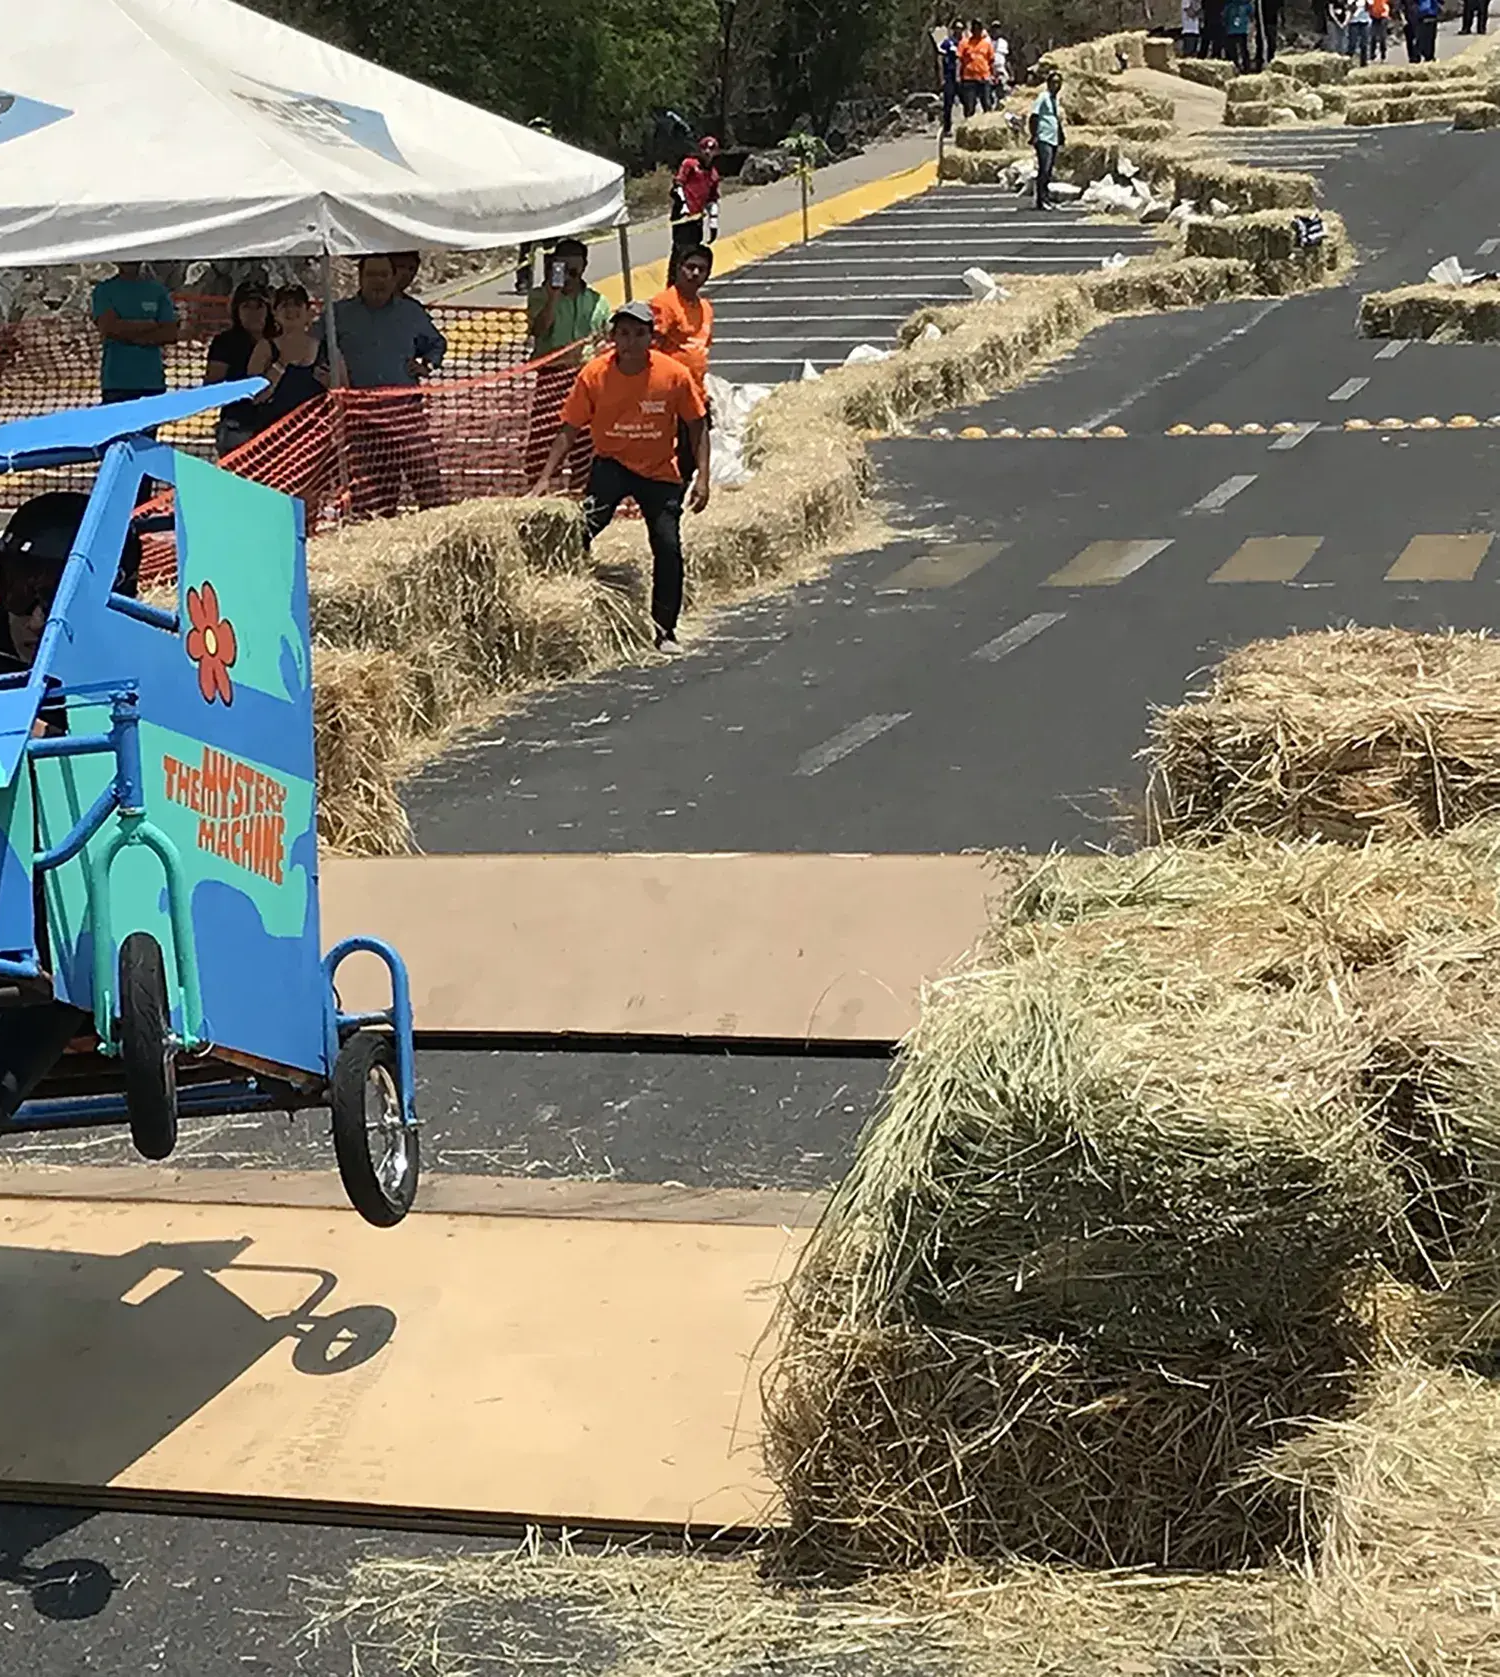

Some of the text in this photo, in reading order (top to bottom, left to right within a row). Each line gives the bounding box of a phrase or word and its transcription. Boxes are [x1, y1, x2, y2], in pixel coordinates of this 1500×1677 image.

[162, 746, 288, 819] THE MYSTERY
[197, 813, 286, 886] MACHINE
